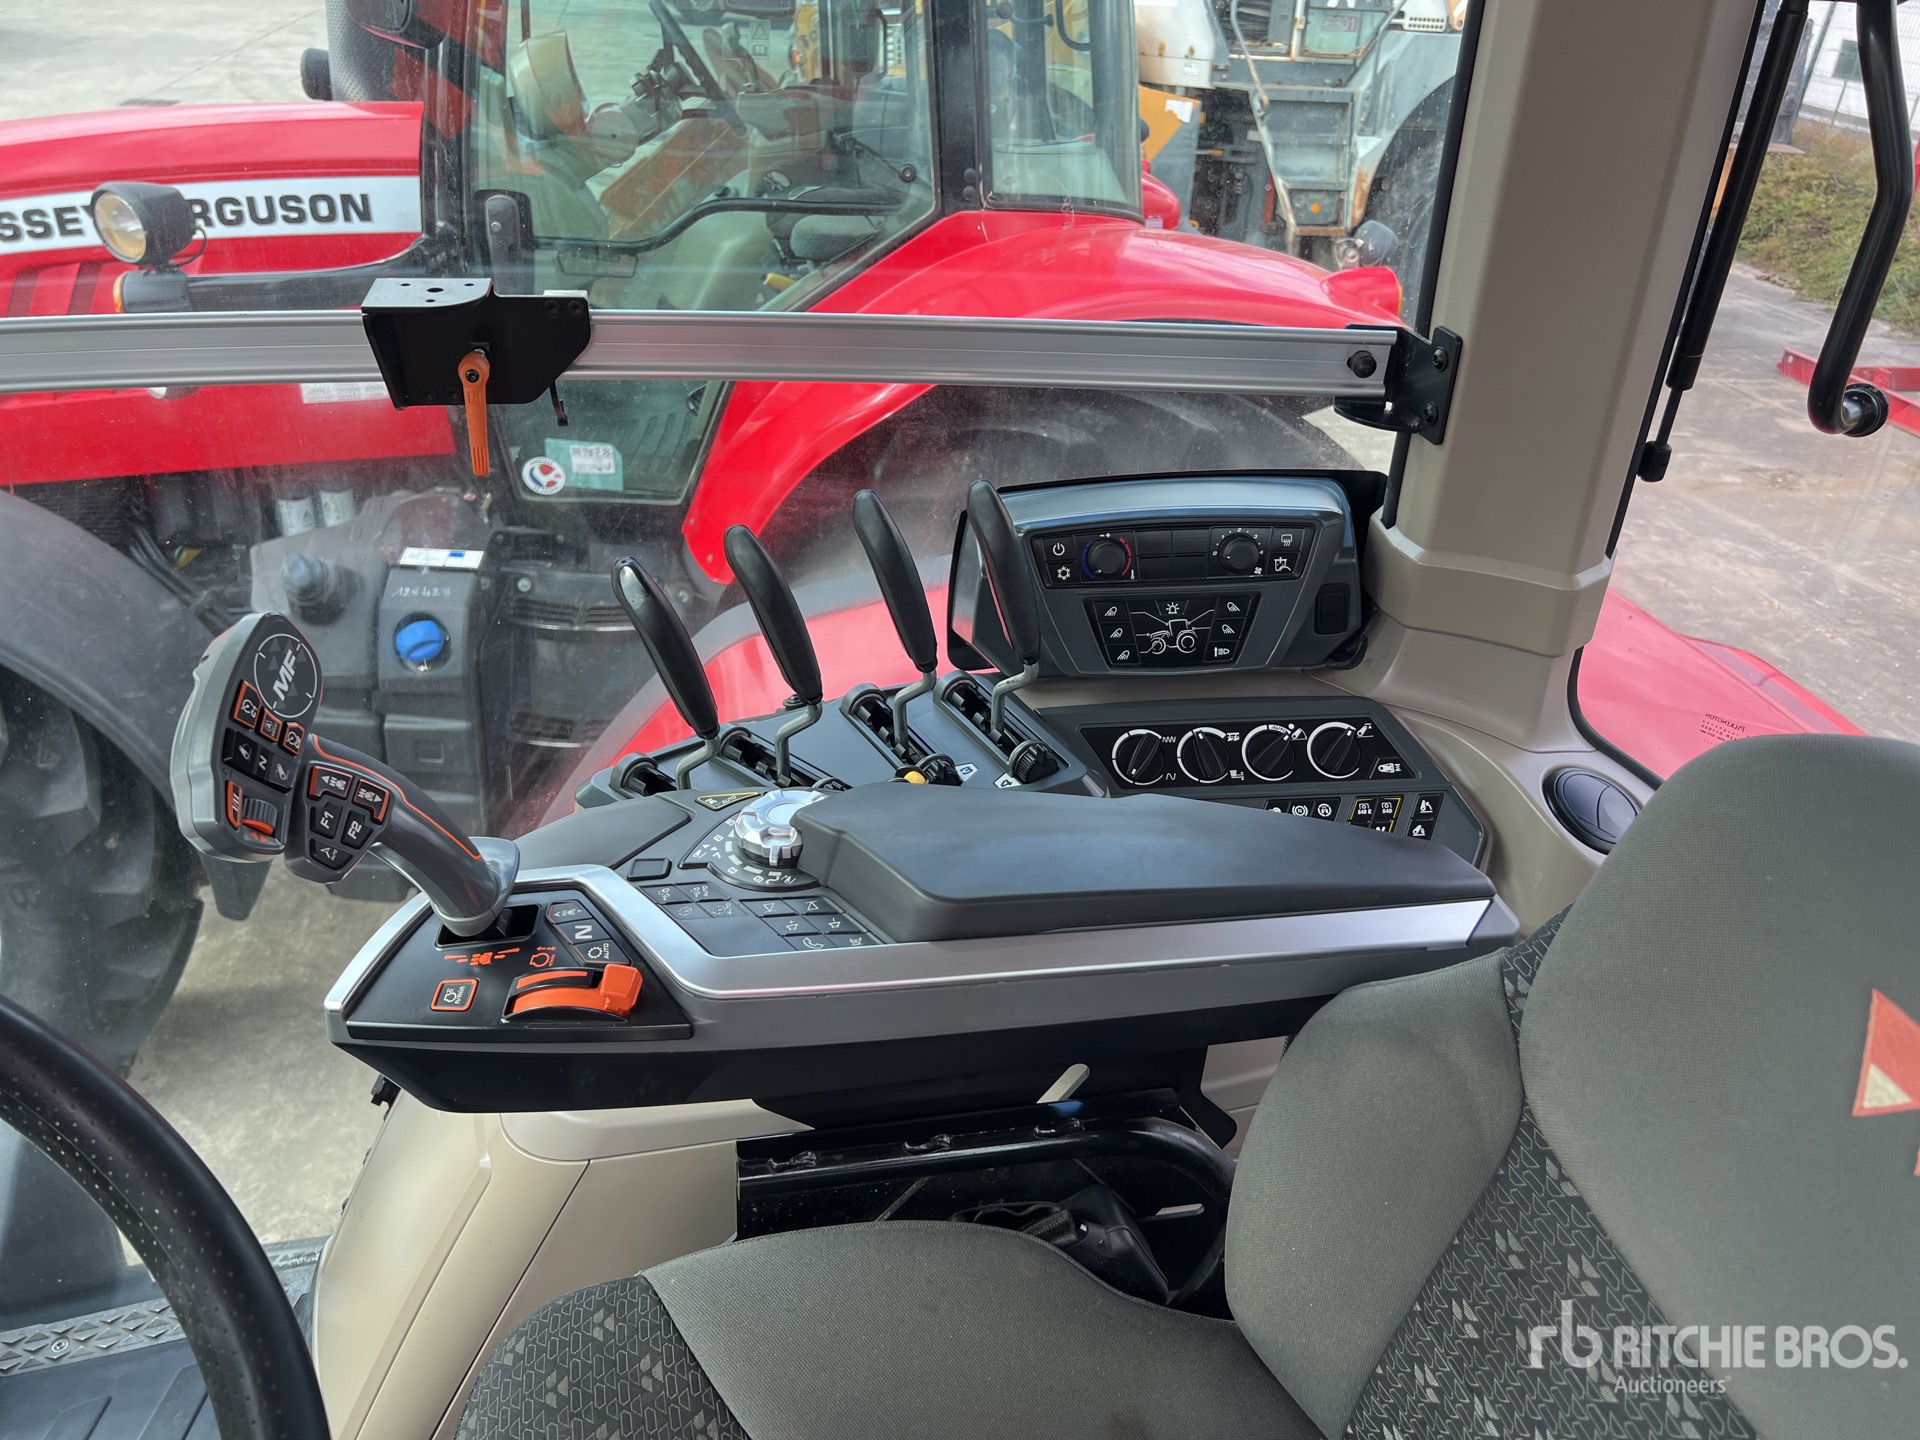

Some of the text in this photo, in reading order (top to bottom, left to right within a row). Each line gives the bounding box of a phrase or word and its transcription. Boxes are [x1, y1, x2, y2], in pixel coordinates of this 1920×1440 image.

[0, 193, 374, 241] SSE RGUSON
[273, 649, 296, 701] MF
[258, 755, 268, 771] N
[959, 766, 973, 776] 3
[320, 811, 335, 829] F1
[347, 820, 362, 840] F2
[574, 924, 593, 939] N
